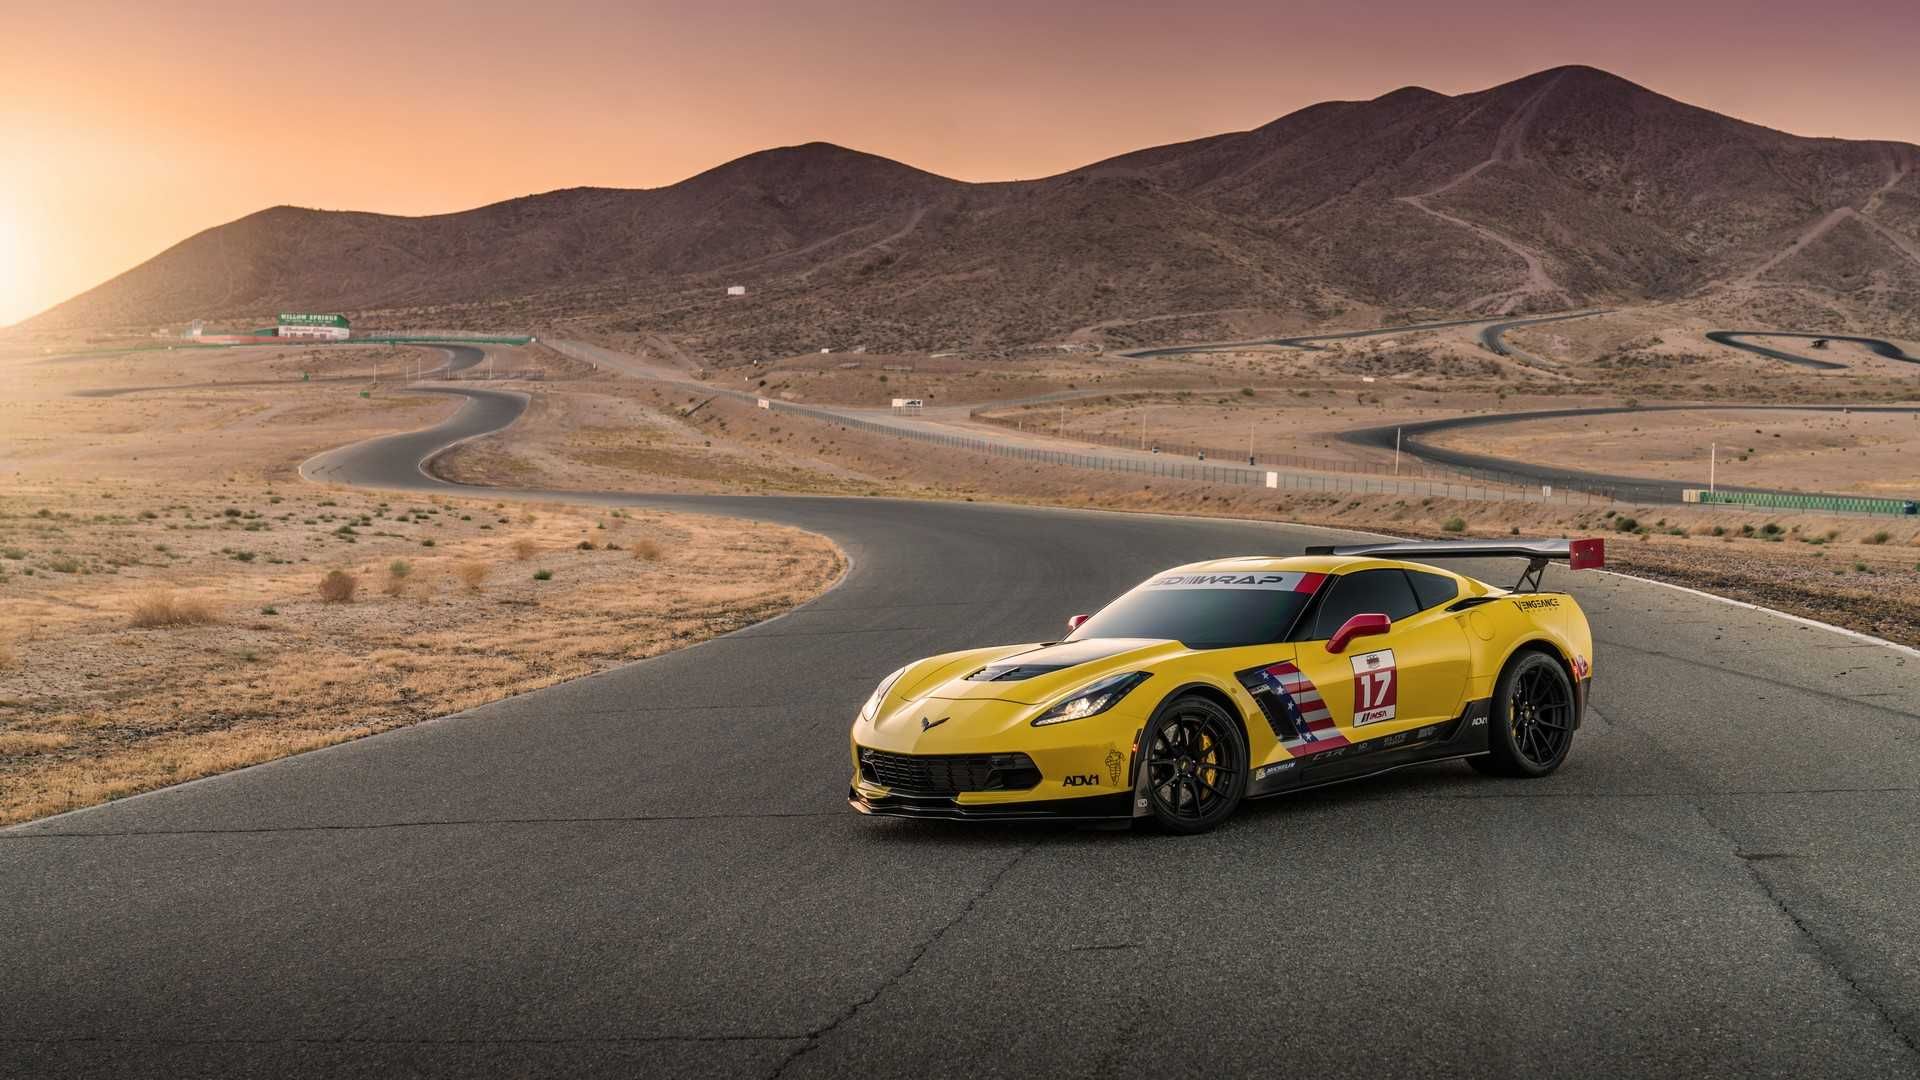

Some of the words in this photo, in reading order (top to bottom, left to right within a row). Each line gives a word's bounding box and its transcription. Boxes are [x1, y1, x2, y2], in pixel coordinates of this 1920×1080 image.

[1512, 598, 1561, 613] VENGEANCE
[1360, 670, 1392, 709] 17
[1369, 710, 1387, 720] IMSA
